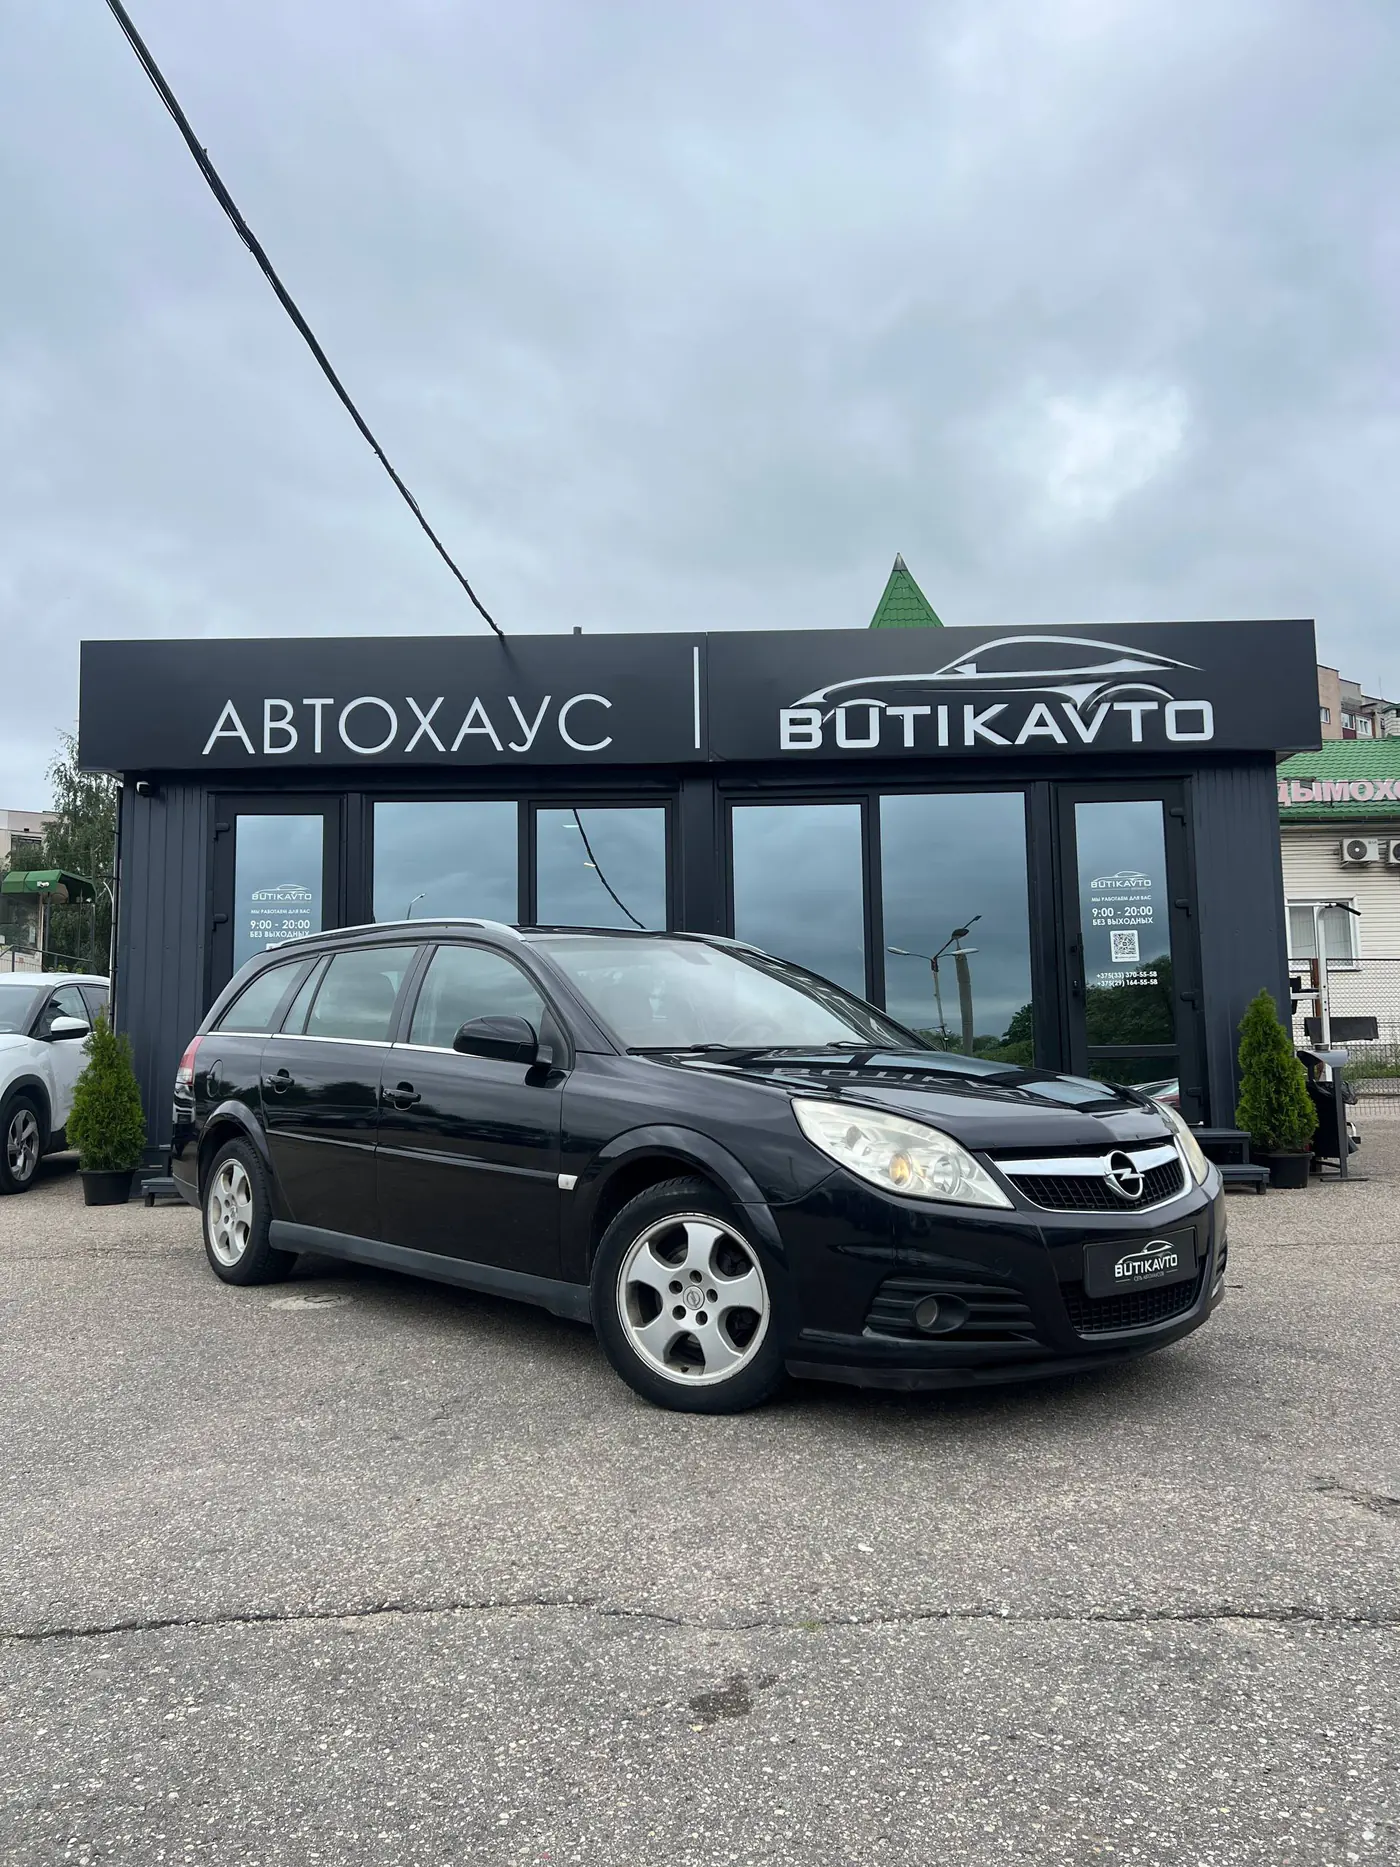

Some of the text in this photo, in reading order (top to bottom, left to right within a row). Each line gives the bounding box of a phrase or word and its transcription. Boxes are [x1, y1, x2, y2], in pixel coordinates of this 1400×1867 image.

[202, 694, 613, 755] АВТОХАУС
[779, 699, 1215, 750] BUTIKAVTO
[1090, 879, 1152, 888] BUTIKAVTO
[1092, 907, 1114, 917] 9:00
[1124, 906, 1153, 916] 20:00
[250, 920, 272, 930] 9:00
[281, 919, 311, 929] 20:00
[1092, 917, 1154, 926] БЕЗ ВЫХОДНЫХ
[249, 930, 310, 938] БЕЗ ВЫХОДНЫХ
[1115, 1254, 1178, 1277] BUTIKAVTO
